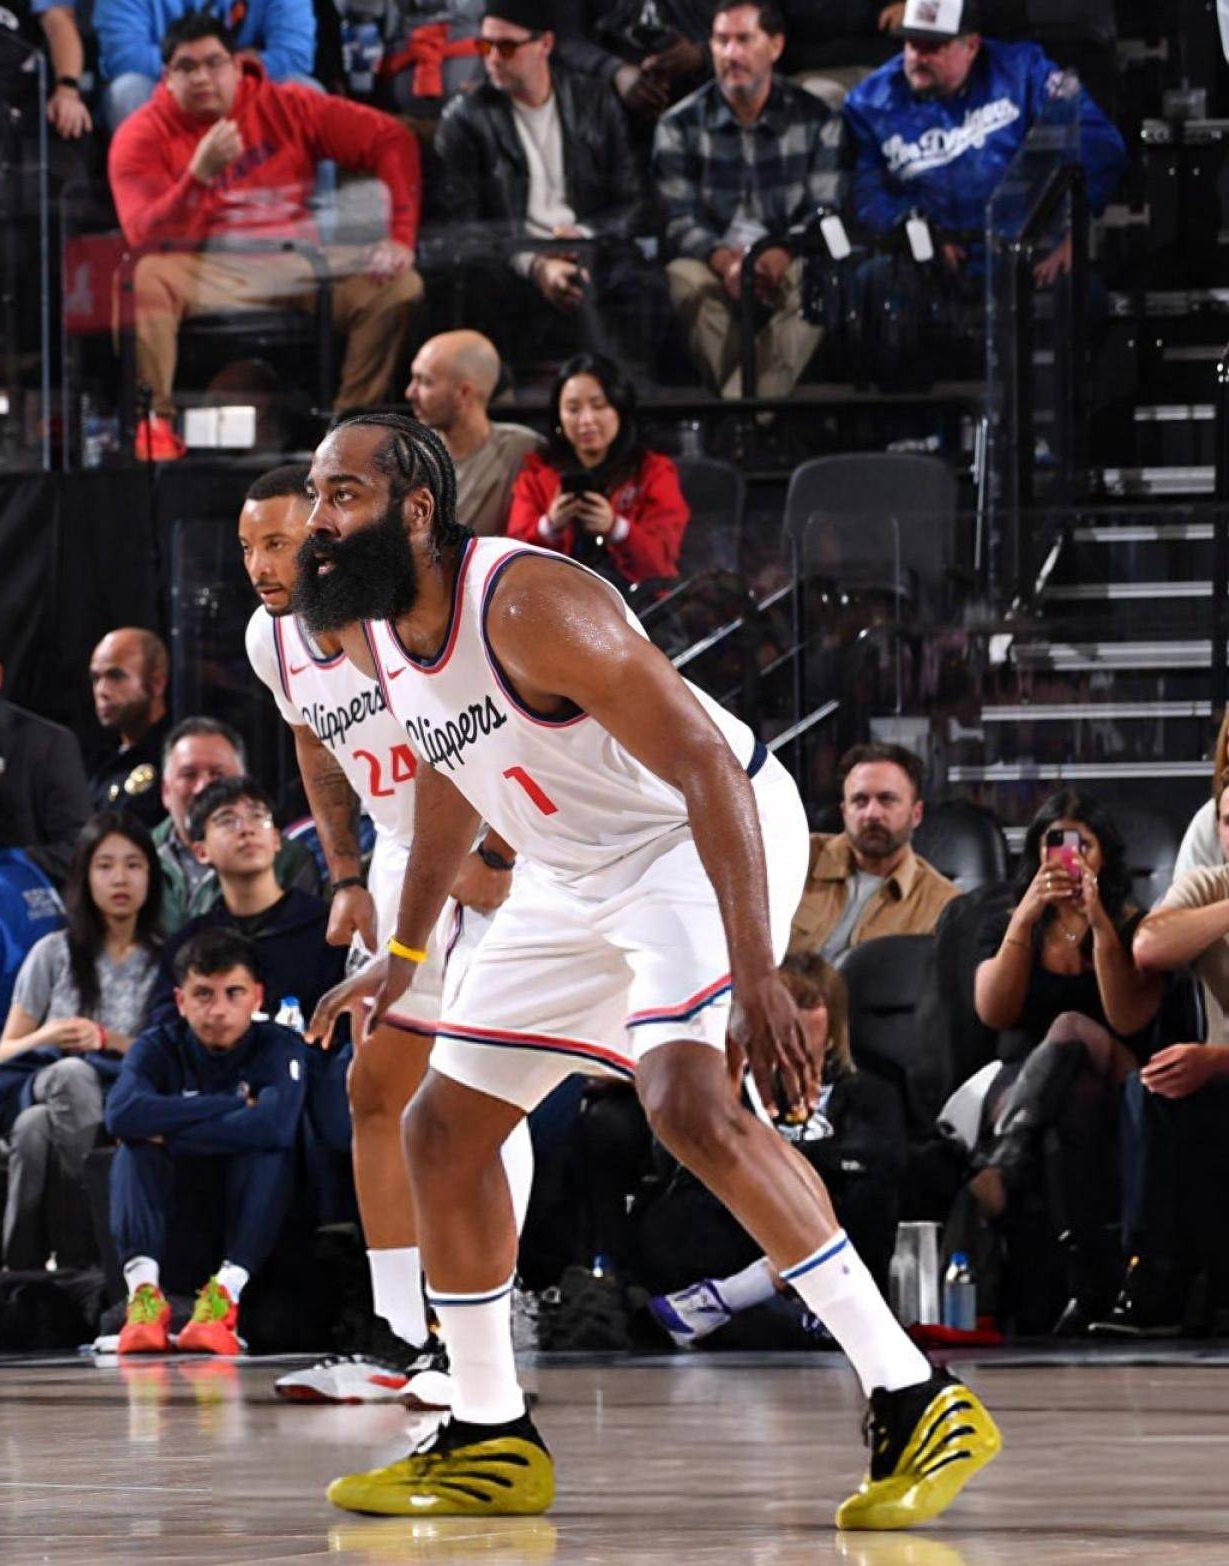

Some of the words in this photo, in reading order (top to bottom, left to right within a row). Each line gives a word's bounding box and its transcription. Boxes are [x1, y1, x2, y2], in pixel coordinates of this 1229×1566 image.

[302, 682, 386, 748] Clippers
[405, 695, 507, 770] Clippers
[502, 766, 558, 816] 1
